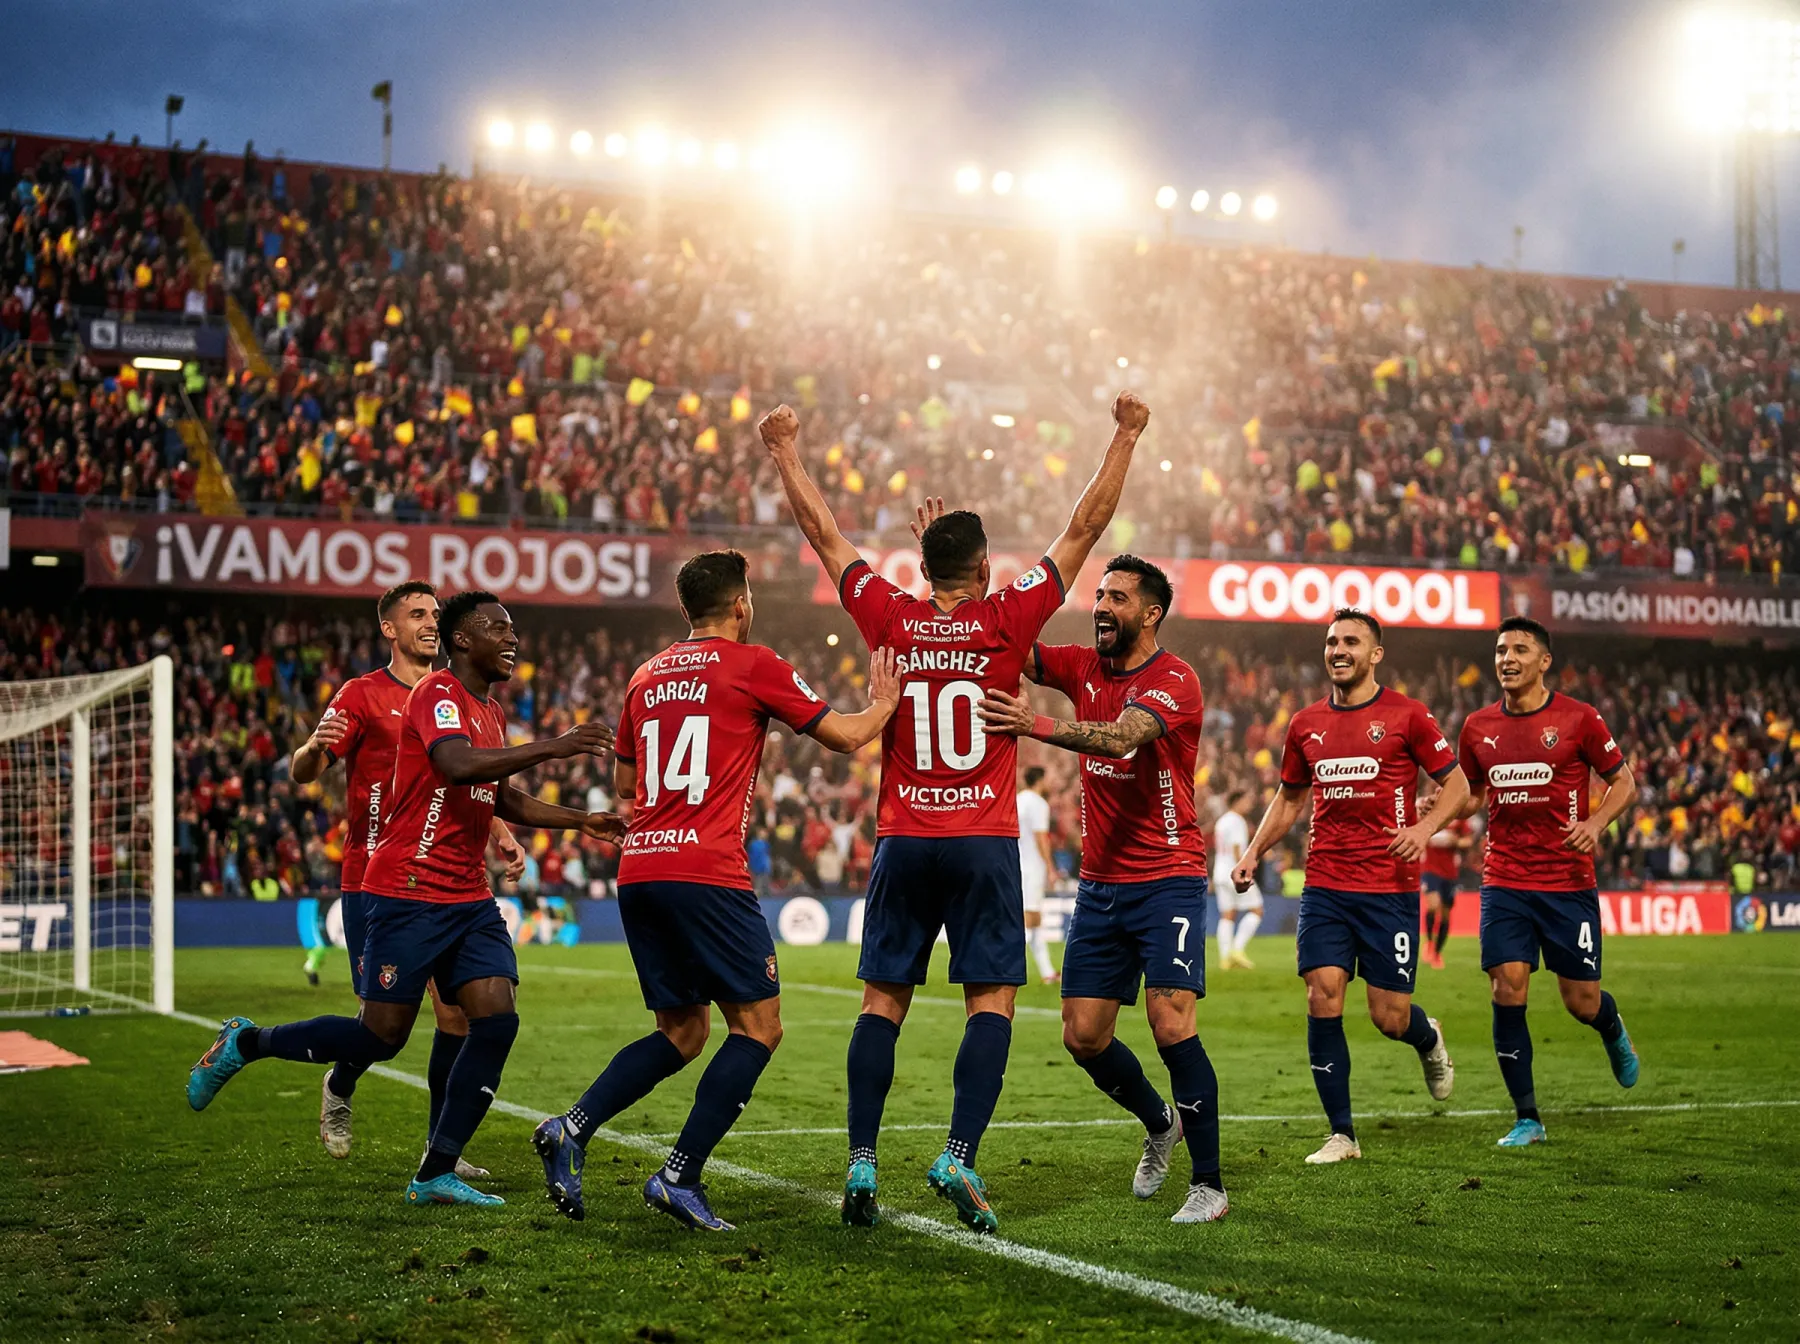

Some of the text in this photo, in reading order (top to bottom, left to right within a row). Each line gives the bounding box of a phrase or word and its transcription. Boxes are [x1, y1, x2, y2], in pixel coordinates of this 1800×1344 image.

[156, 522, 651, 598] ¡VAMOS ROJOS!
[1208, 563, 1485, 625] GOOOOOL
[1552, 585, 1649, 622] PASIÓN
[902, 618, 984, 635] VICTORIA
[647, 651, 720, 671] VICTORIA
[896, 646, 990, 676] SÁNCHEZ
[643, 676, 708, 709] GARCÍA
[903, 681, 986, 770] 10
[640, 715, 711, 807] 14
[1317, 763, 1376, 777] Colanta
[1490, 768, 1550, 782] Colanta
[897, 784, 996, 804] VICTORIA
[1322, 786, 1354, 800] VIGA
[1497, 791, 1529, 804] VIGA
[1620, 895, 1703, 936] LIGA
[1171, 916, 1190, 952] 7
[1394, 931, 1410, 964] 9
[1577, 921, 1594, 953] 4
